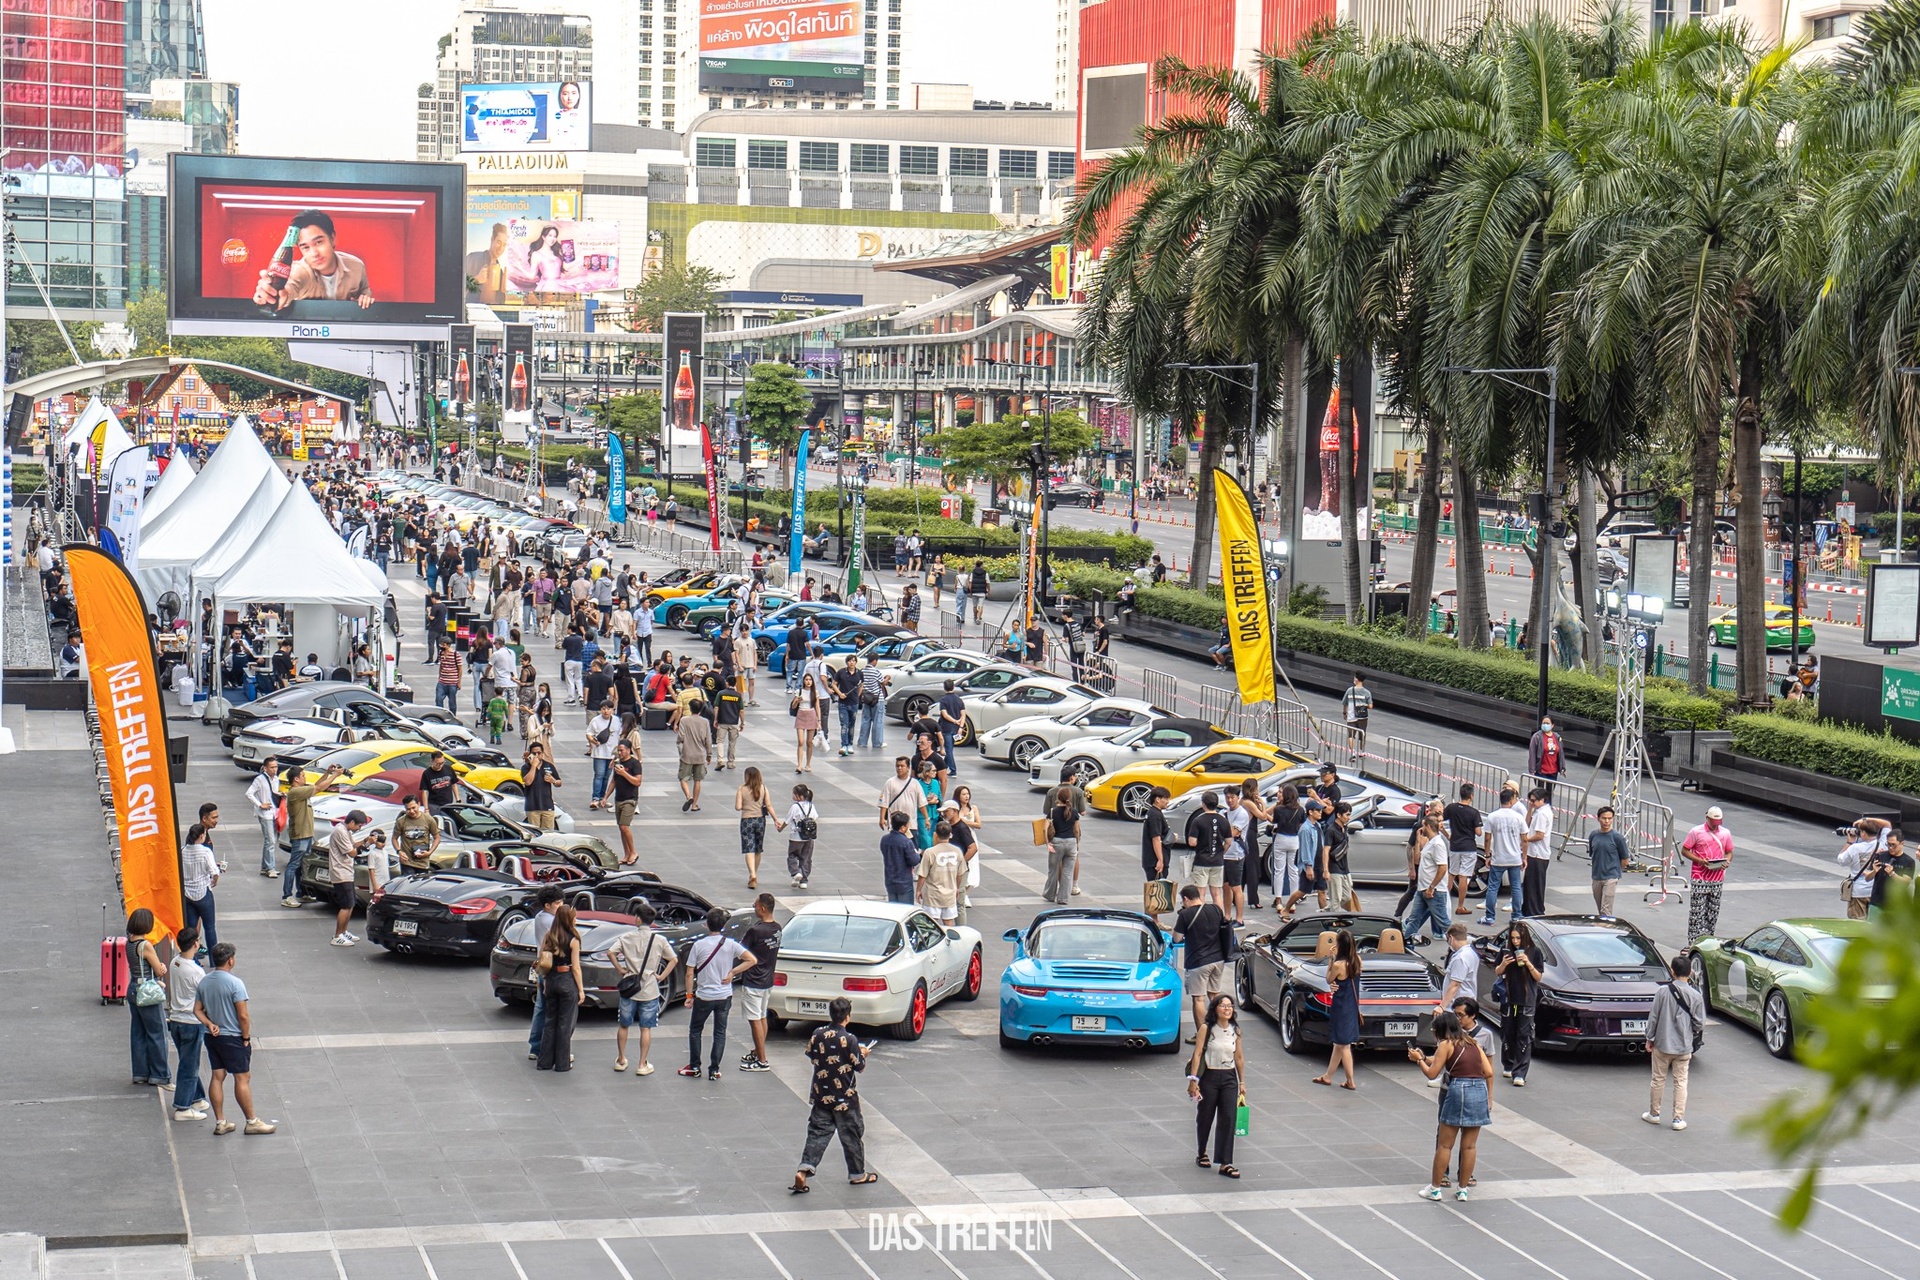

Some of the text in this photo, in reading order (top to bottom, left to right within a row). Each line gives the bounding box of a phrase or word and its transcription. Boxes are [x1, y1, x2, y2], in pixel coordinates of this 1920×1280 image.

[707, 8, 853, 44] แค่ล้าง ผิวดูใสทันที
[490, 108, 534, 116] THIAMIDOL
[478, 154, 569, 170] PALLADIUM
[804, 330, 840, 341] MARKET
[612, 454, 622, 506] DAS TREFFEN
[793, 470, 805, 534] DAS TREFFEN
[852, 547, 861, 570] DAS
[1230, 540, 1262, 642] DAS TREFFEN
[106, 660, 159, 842] DAS TREFFEN
[814, 1002, 827, 1010] 968
[1094, 1017, 1099, 1025] 2
[1402, 1022, 1415, 1031] 997
